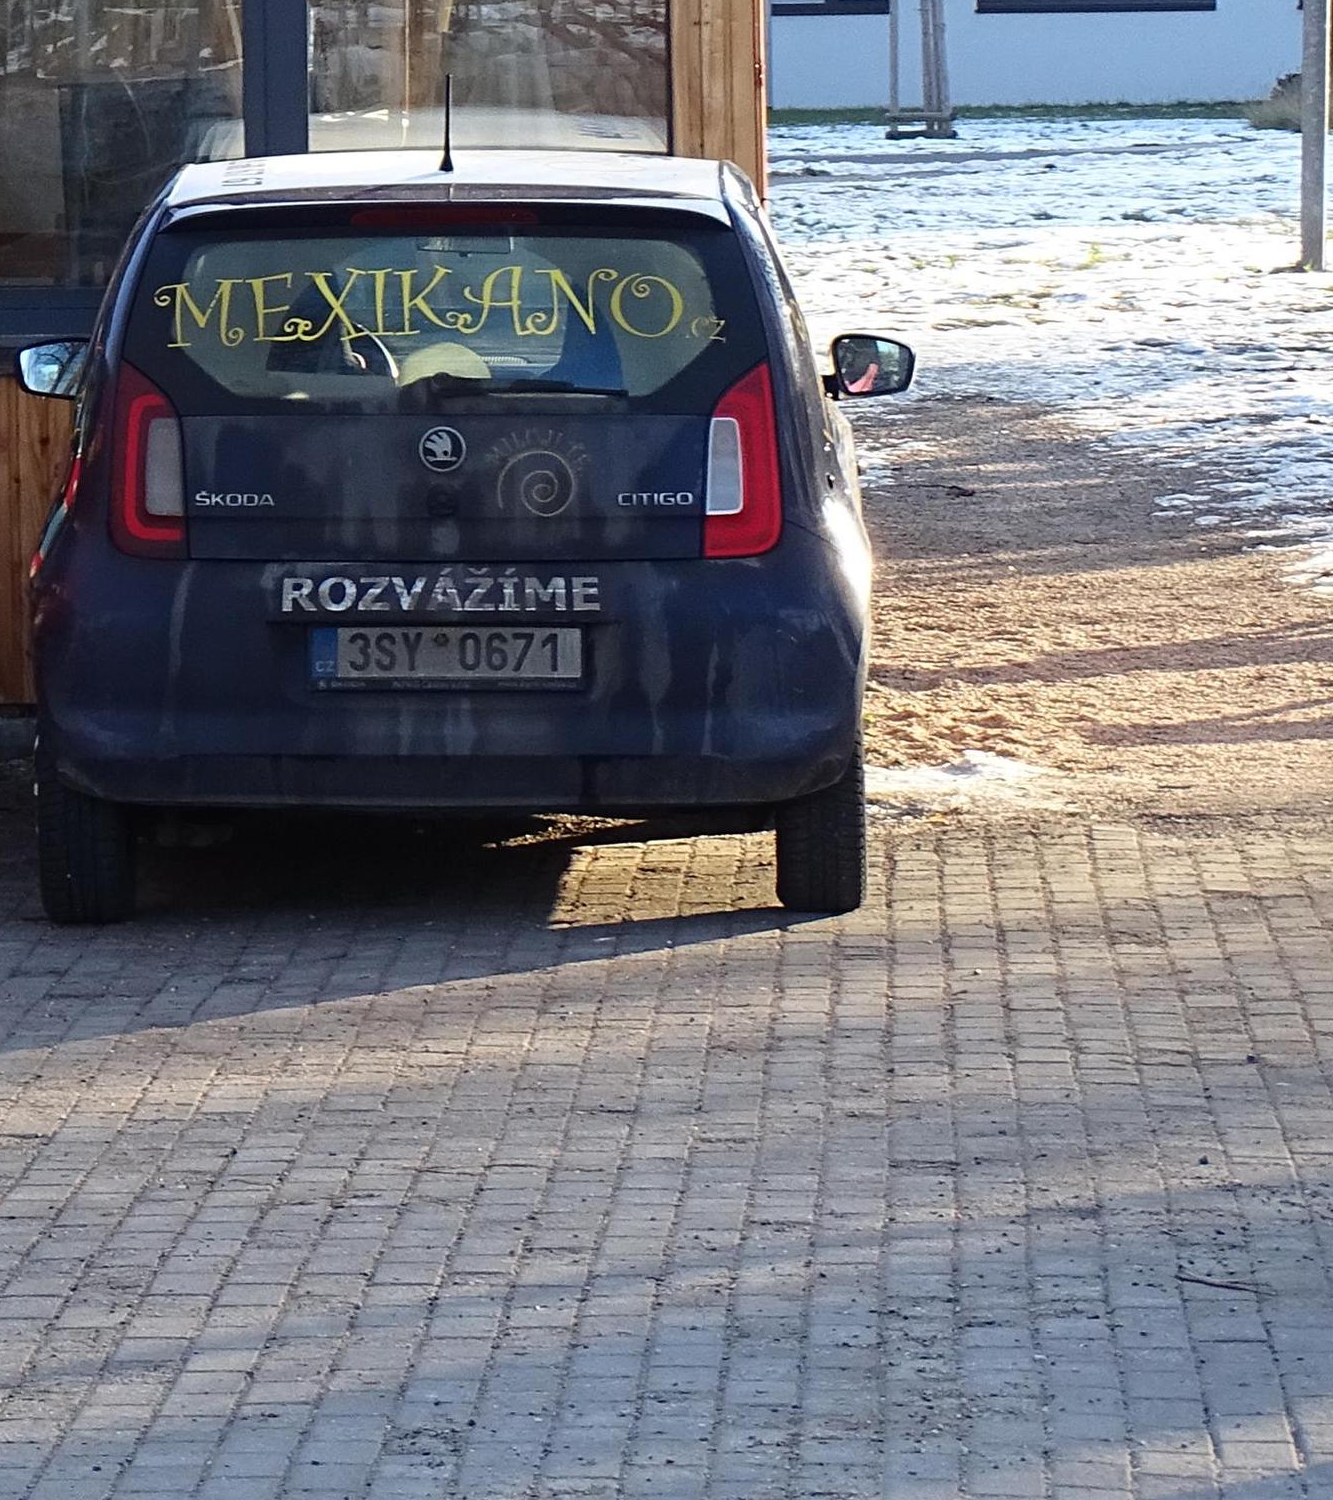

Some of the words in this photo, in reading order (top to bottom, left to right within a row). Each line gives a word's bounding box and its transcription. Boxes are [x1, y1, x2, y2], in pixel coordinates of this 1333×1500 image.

[195, 490, 275, 506] ŠKODA
[617, 492, 693, 506] CITIGO
[282, 568, 600, 612] ROZVÁŽÍME
[348, 632, 423, 672] 3SY
[458, 632, 559, 672] 0671
